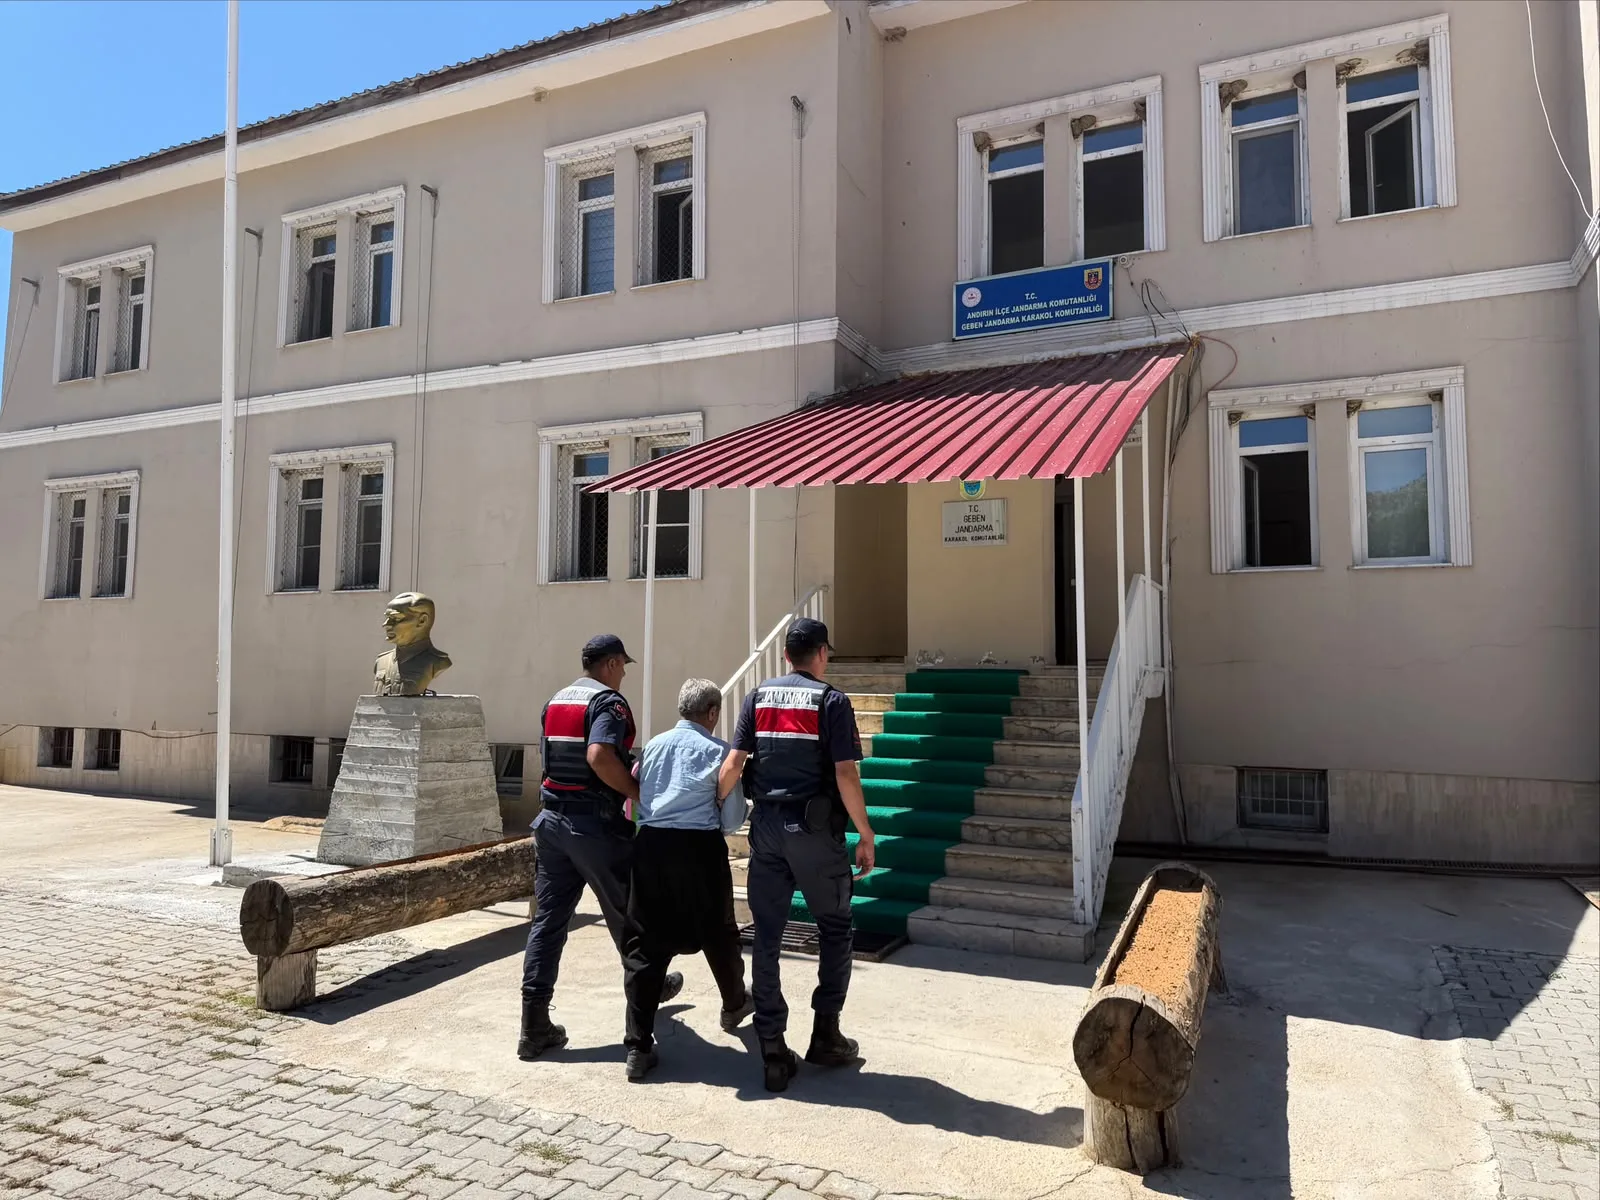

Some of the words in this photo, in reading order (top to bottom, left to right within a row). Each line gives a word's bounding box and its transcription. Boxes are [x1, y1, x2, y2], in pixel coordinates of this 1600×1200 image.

[1025, 292, 1037, 300] T.C.
[966, 309, 994, 320] ANDIRIN
[995, 306, 1010, 316] İLÇE
[1011, 301, 1048, 313] JANDARMA
[1049, 293, 1097, 308] KOMUTANLIĞI
[961, 321, 984, 331] GEBEN
[984, 316, 1020, 328] JANDARMA
[1021, 312, 1054, 323] KARAKOL
[1054, 303, 1103, 318] KOMUTANLIĞI
[963, 514, 986, 523] GEBEN
[954, 524, 994, 534] JANDARMA
[970, 533, 1005, 541] KOMUTANLIĞI
[761, 689, 812, 705] JANDARMA
